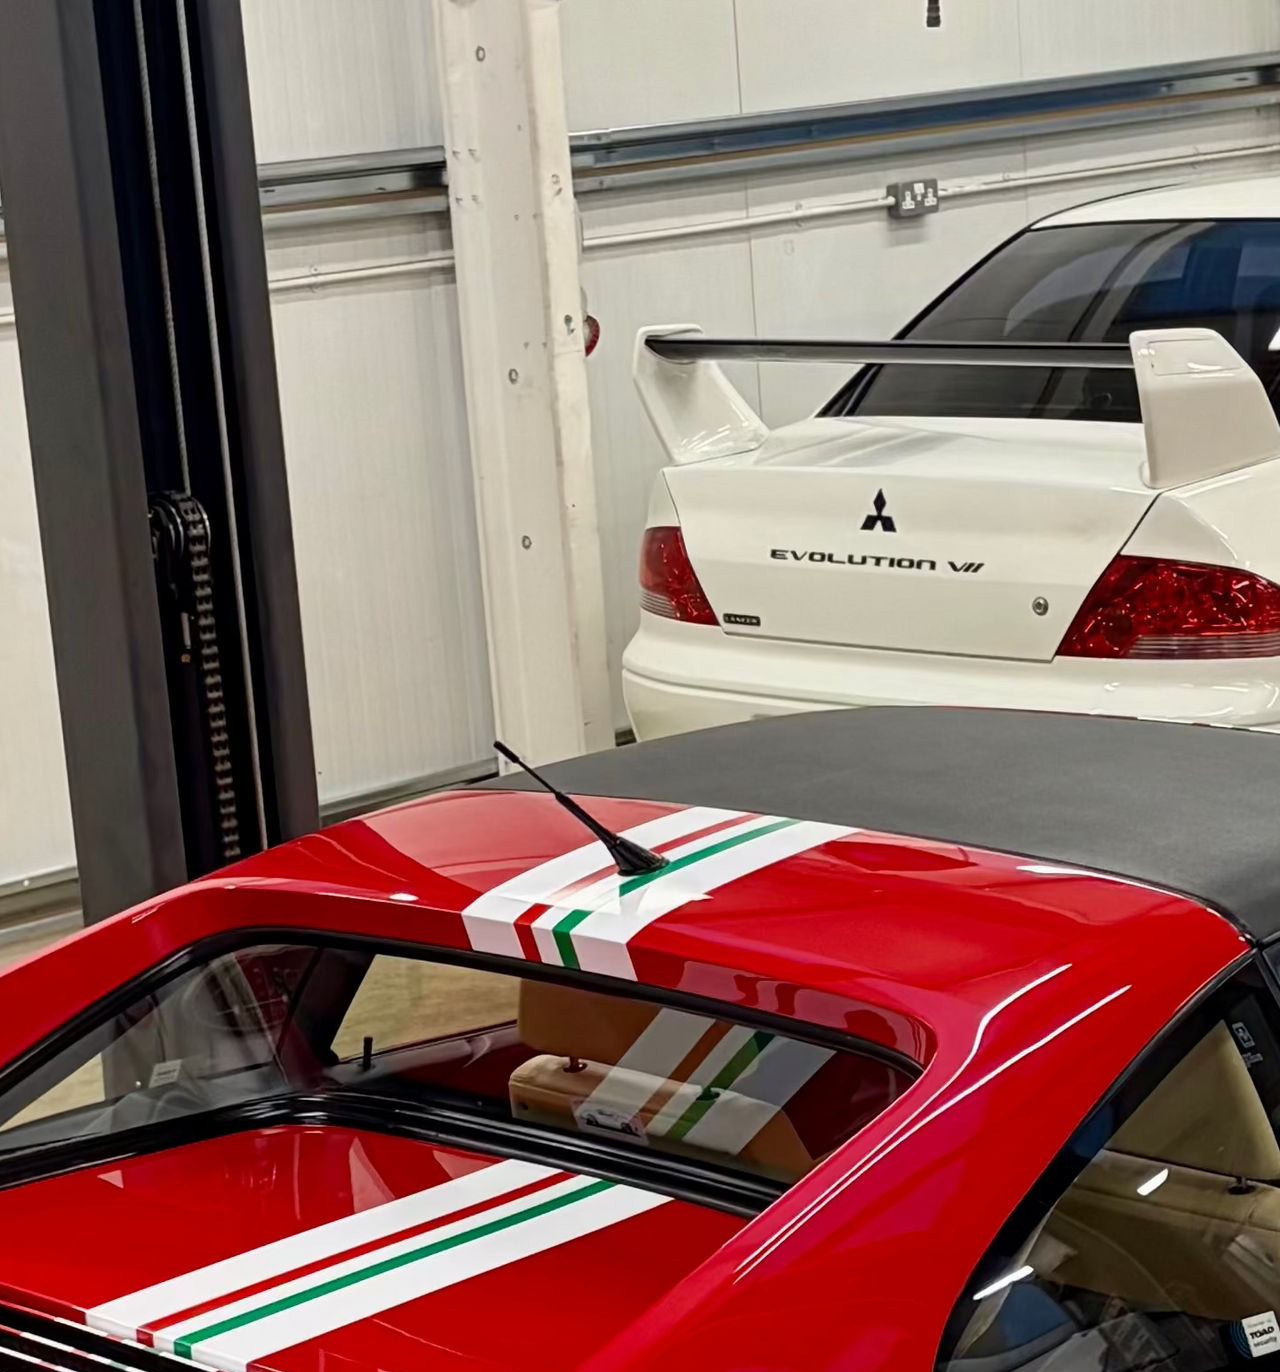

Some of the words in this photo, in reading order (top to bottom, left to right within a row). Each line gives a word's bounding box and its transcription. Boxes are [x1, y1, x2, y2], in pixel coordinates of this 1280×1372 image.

[770, 549, 937, 571] EVOLUTION
[947, 560, 985, 573] VII
[1249, 1326, 1275, 1340] TOAD
